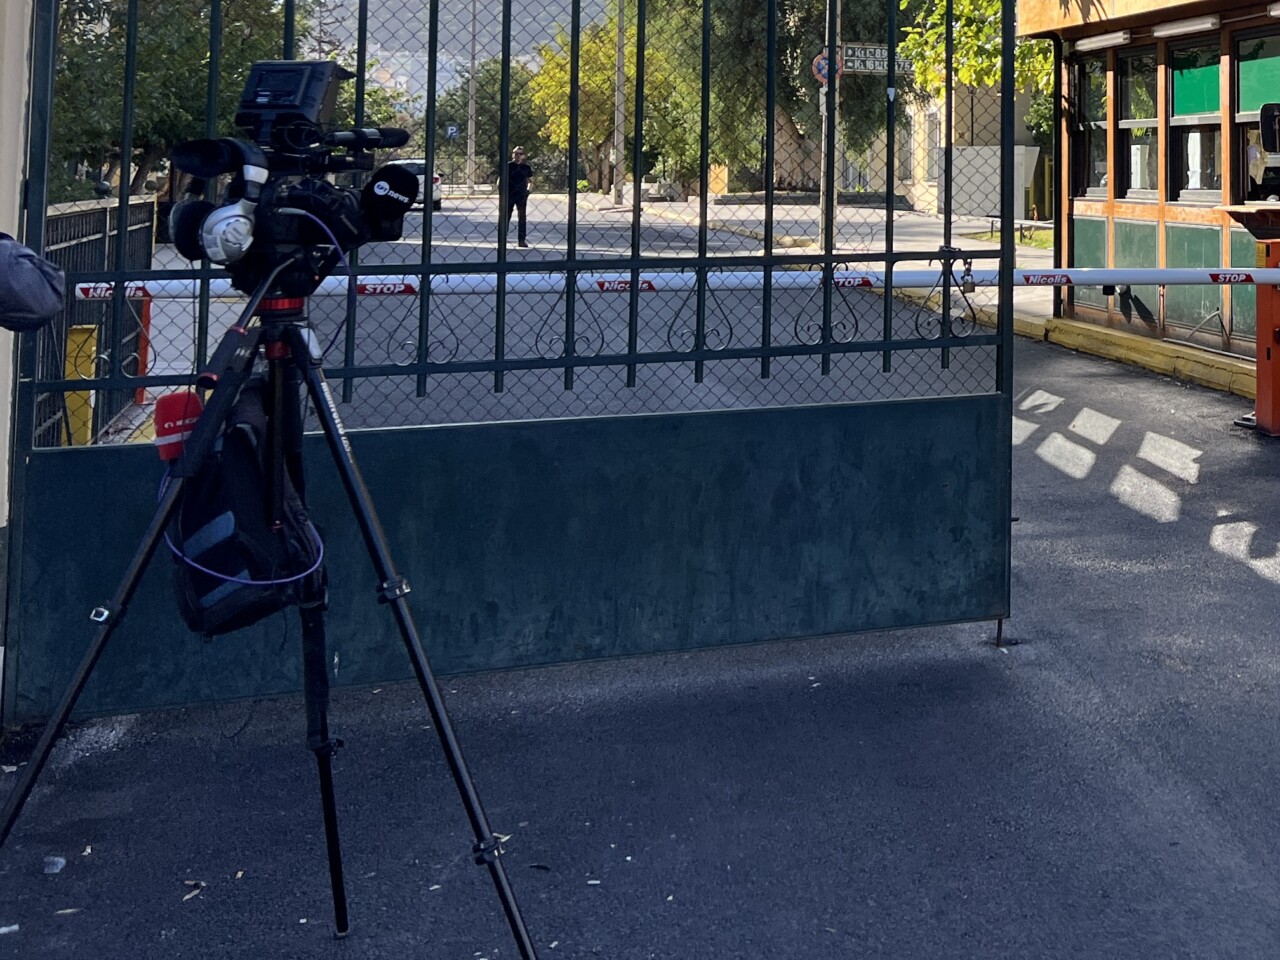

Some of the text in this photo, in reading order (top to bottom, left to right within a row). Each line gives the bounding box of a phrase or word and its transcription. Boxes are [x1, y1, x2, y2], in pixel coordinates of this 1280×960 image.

[387, 190, 409, 203] news
[1028, 275, 1068, 284] Nicolis
[1218, 274, 1247, 283] STOP
[88, 286, 144, 298] Niclis
[364, 284, 406, 294] STOP
